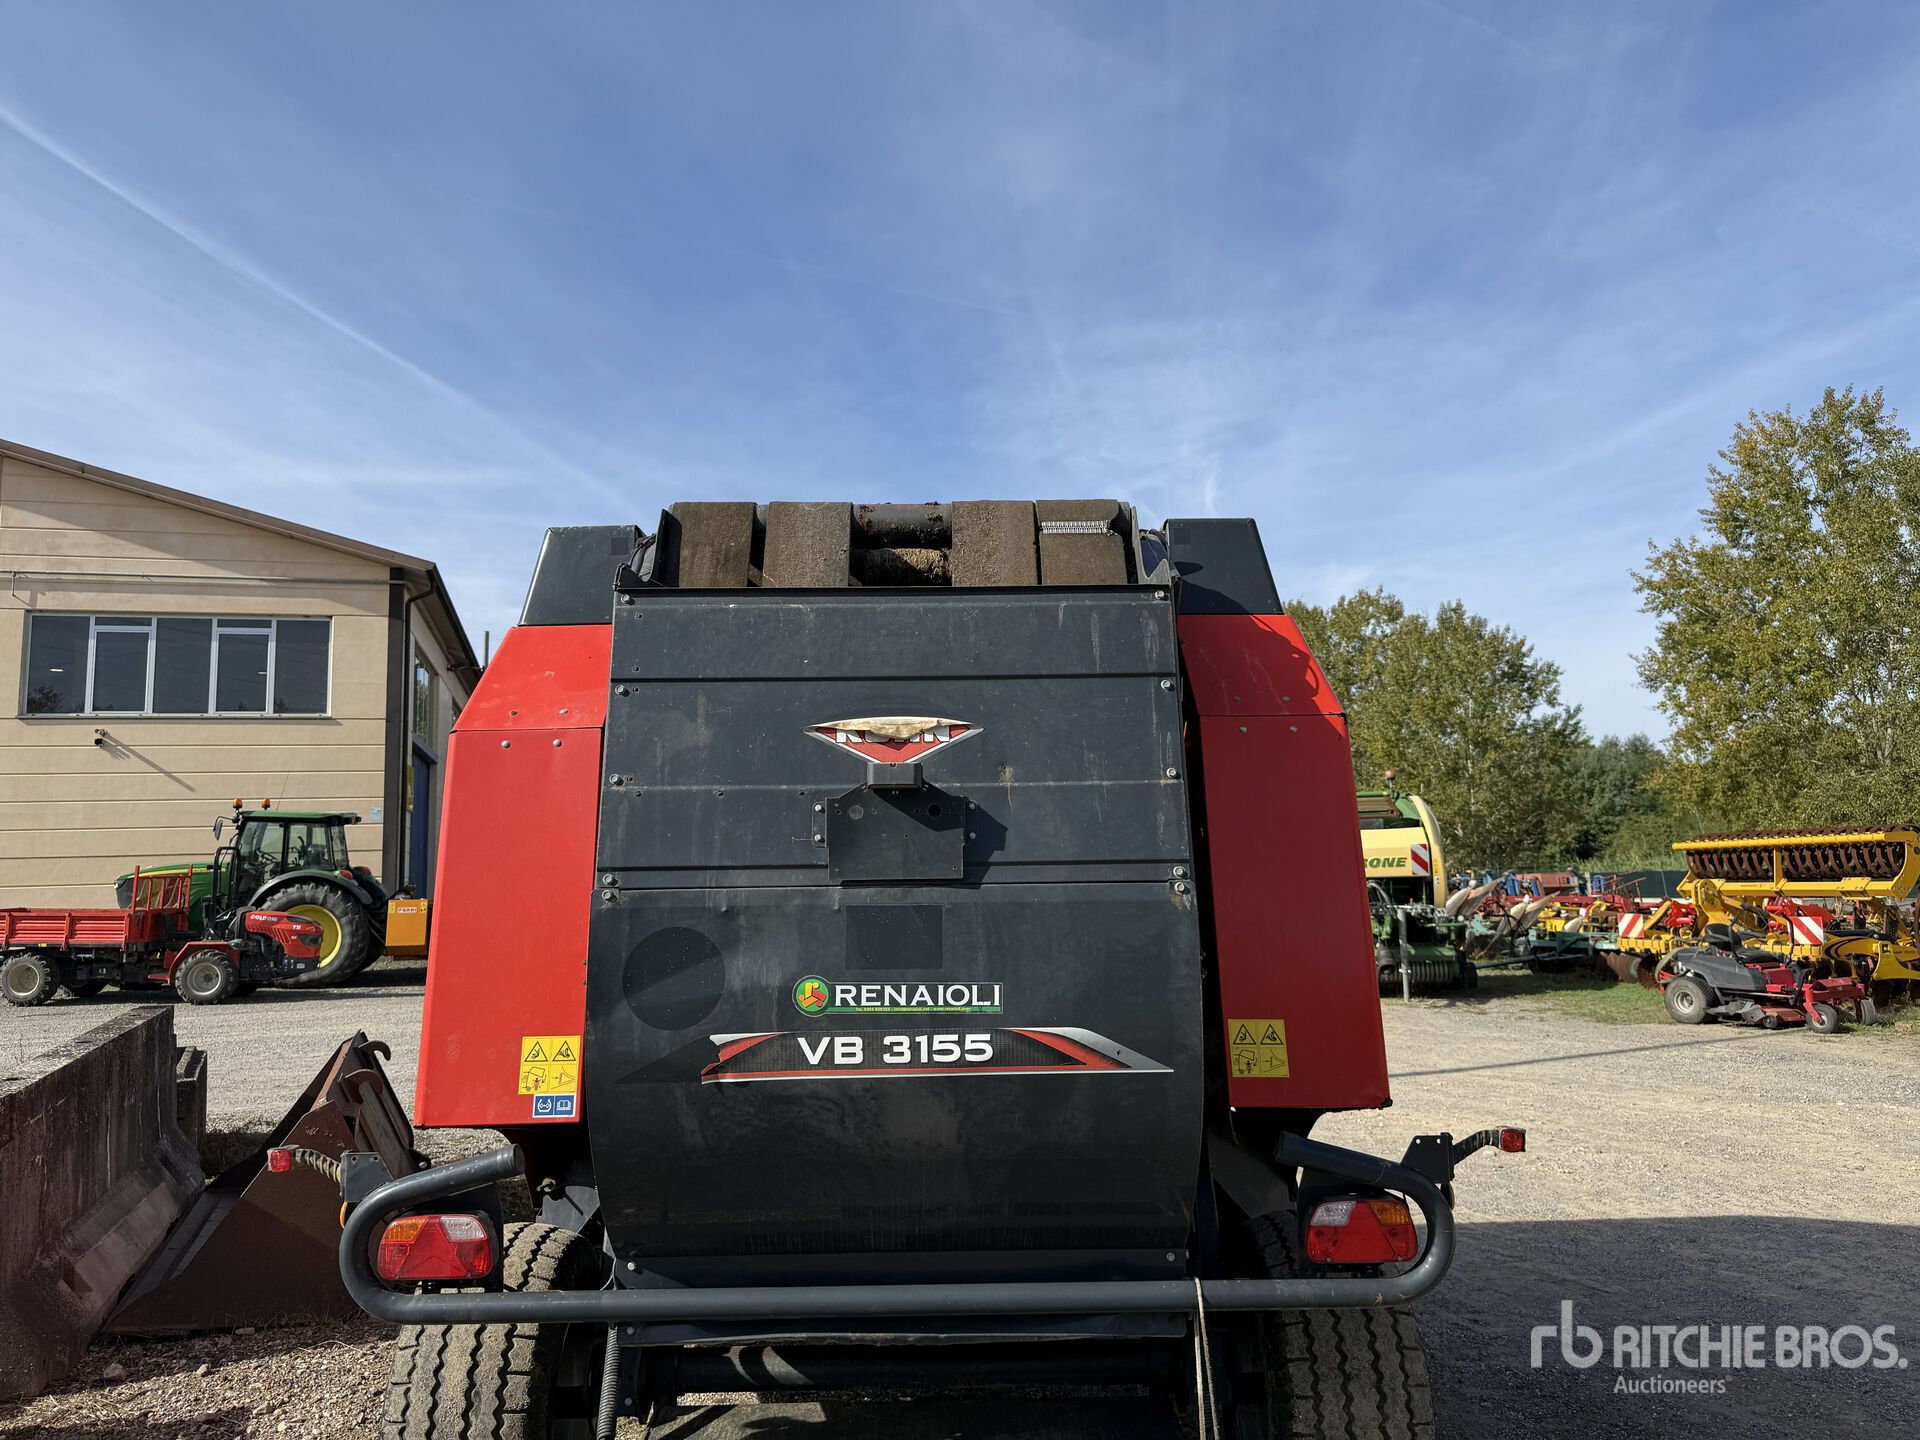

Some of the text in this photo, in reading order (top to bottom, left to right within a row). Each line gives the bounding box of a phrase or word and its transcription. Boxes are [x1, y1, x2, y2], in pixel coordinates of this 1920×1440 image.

[1364, 857, 1407, 868] ONE
[835, 985, 1000, 1006] RENAIOLI
[797, 1034, 994, 1065] VB 3155
